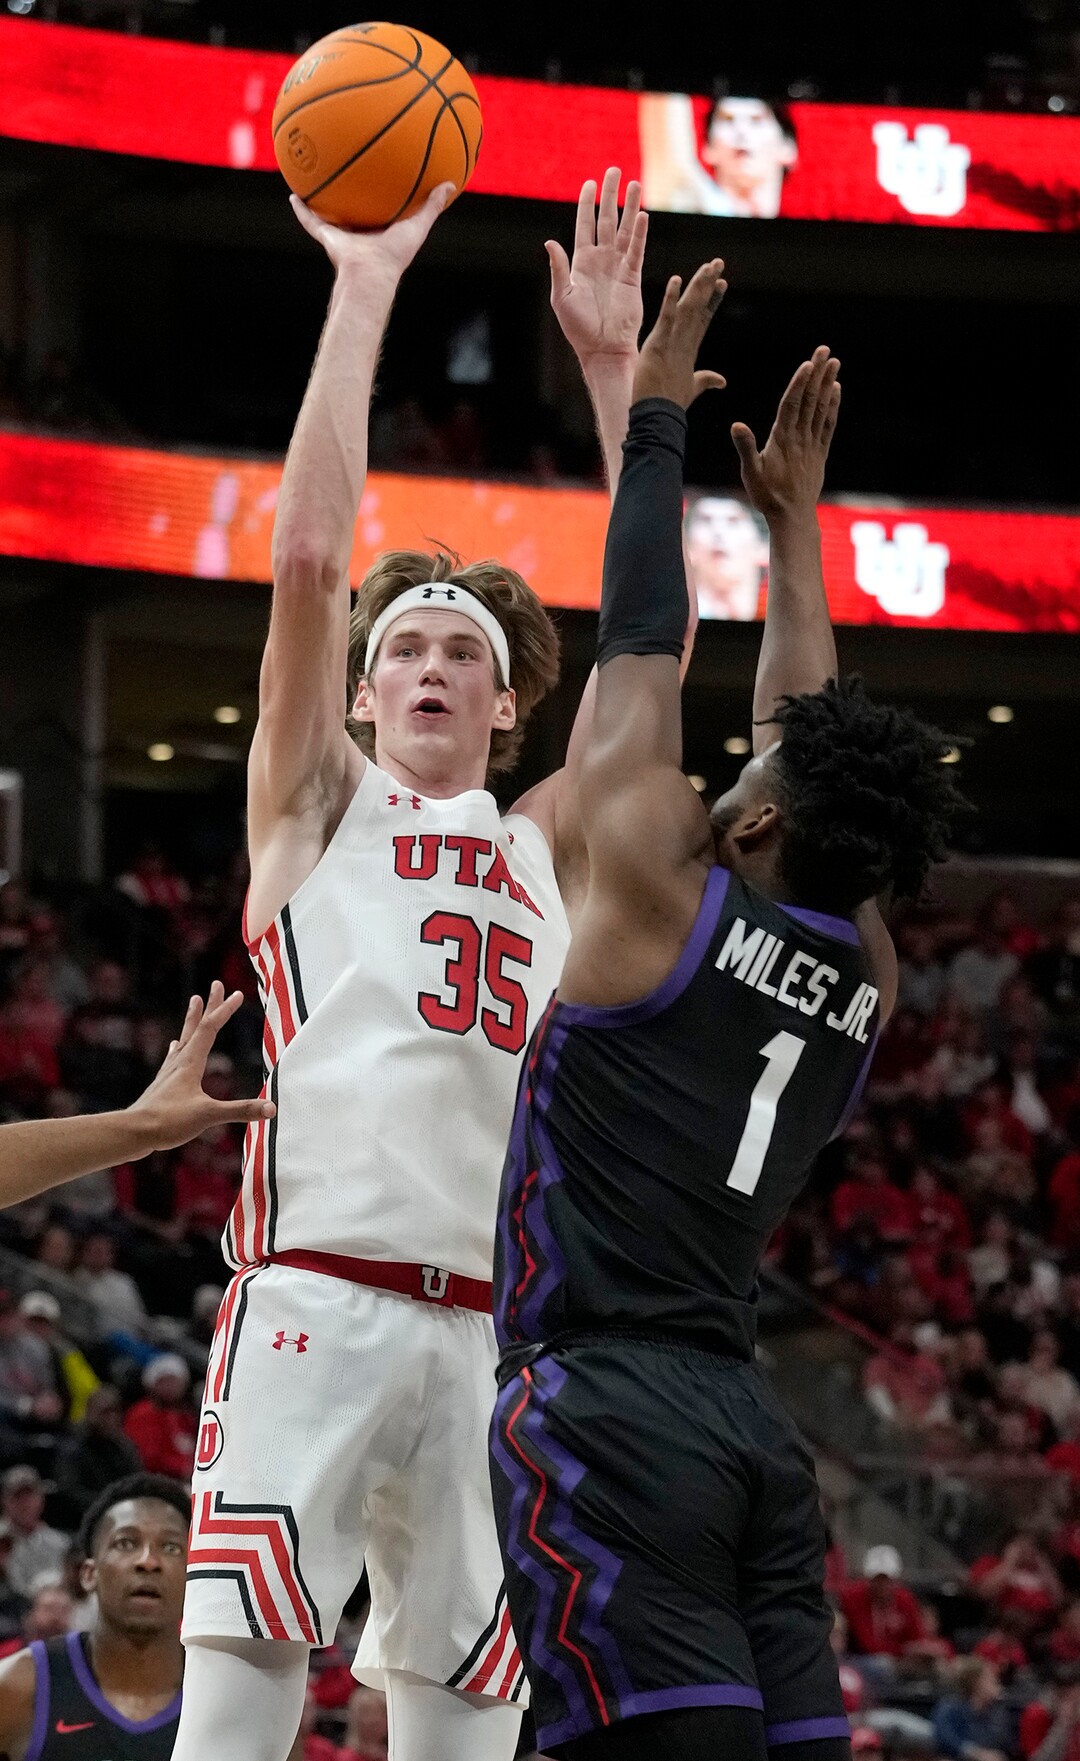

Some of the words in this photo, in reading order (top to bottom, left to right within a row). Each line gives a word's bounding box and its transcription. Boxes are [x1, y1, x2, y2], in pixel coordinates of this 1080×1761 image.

[393, 834, 545, 921] UTA
[418, 910, 533, 1056] 35
[715, 917, 839, 1017] MILES
[726, 1030, 806, 1196] 1
[421, 1267, 450, 1299] U
